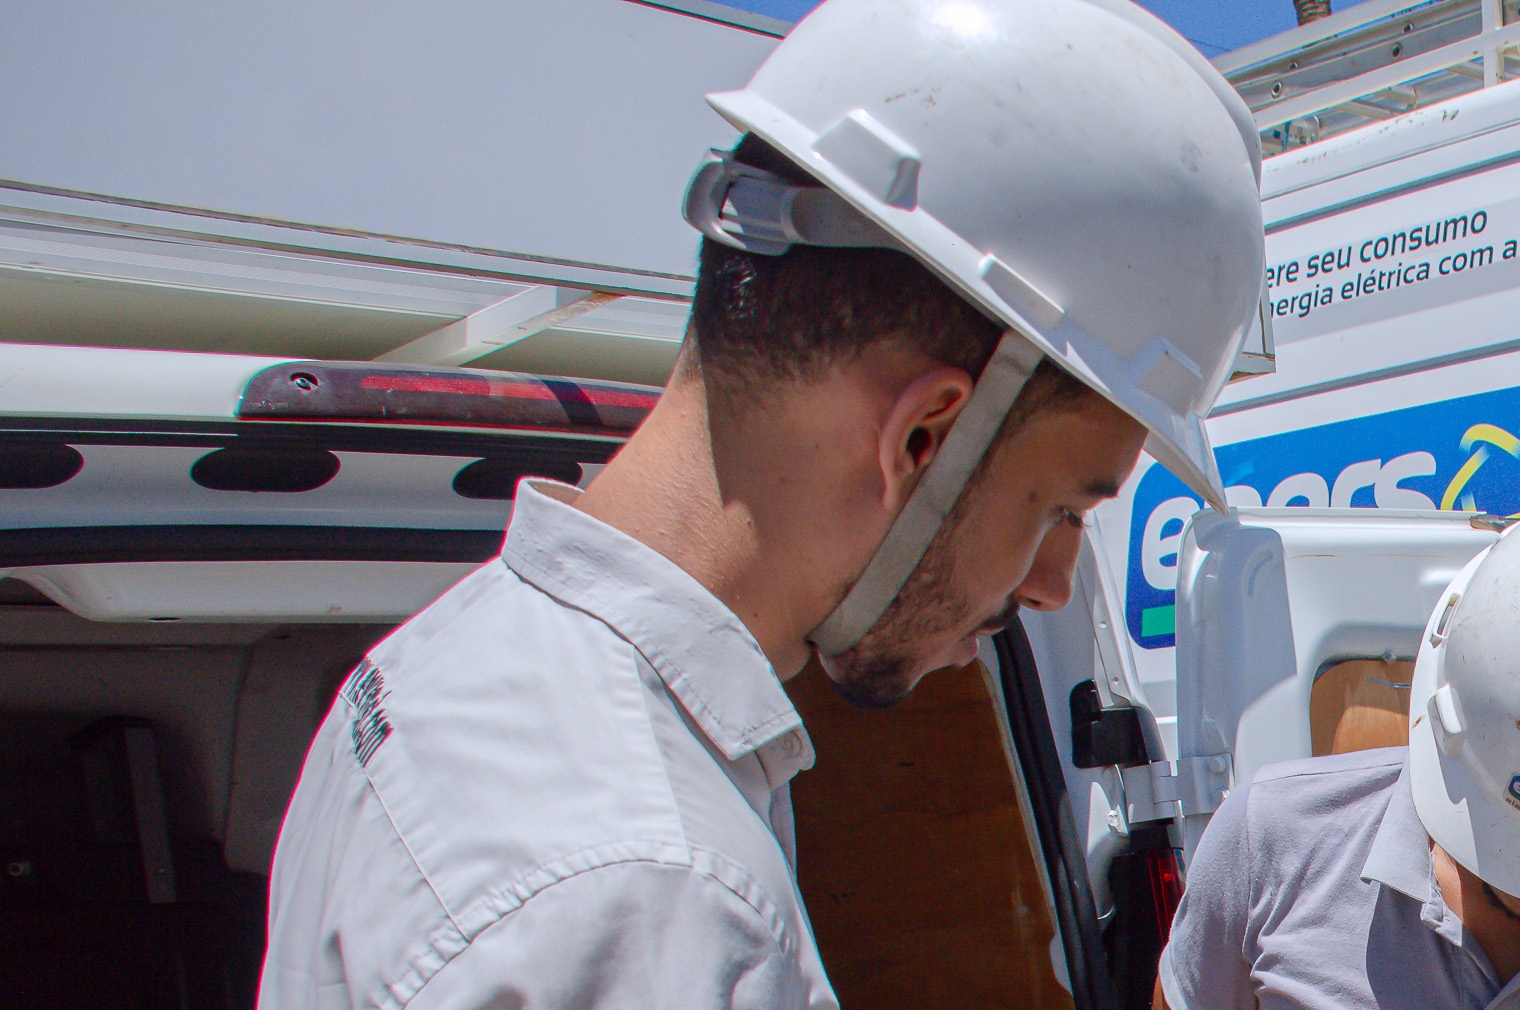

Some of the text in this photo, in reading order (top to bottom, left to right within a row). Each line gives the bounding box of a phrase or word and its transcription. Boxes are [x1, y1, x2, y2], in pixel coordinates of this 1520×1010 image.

[1306, 245, 1352, 278] seu
[1359, 209, 1488, 264] consumo
[1341, 261, 1431, 301] elétrica
[1438, 244, 1494, 276] com
[1502, 239, 1518, 259] a
